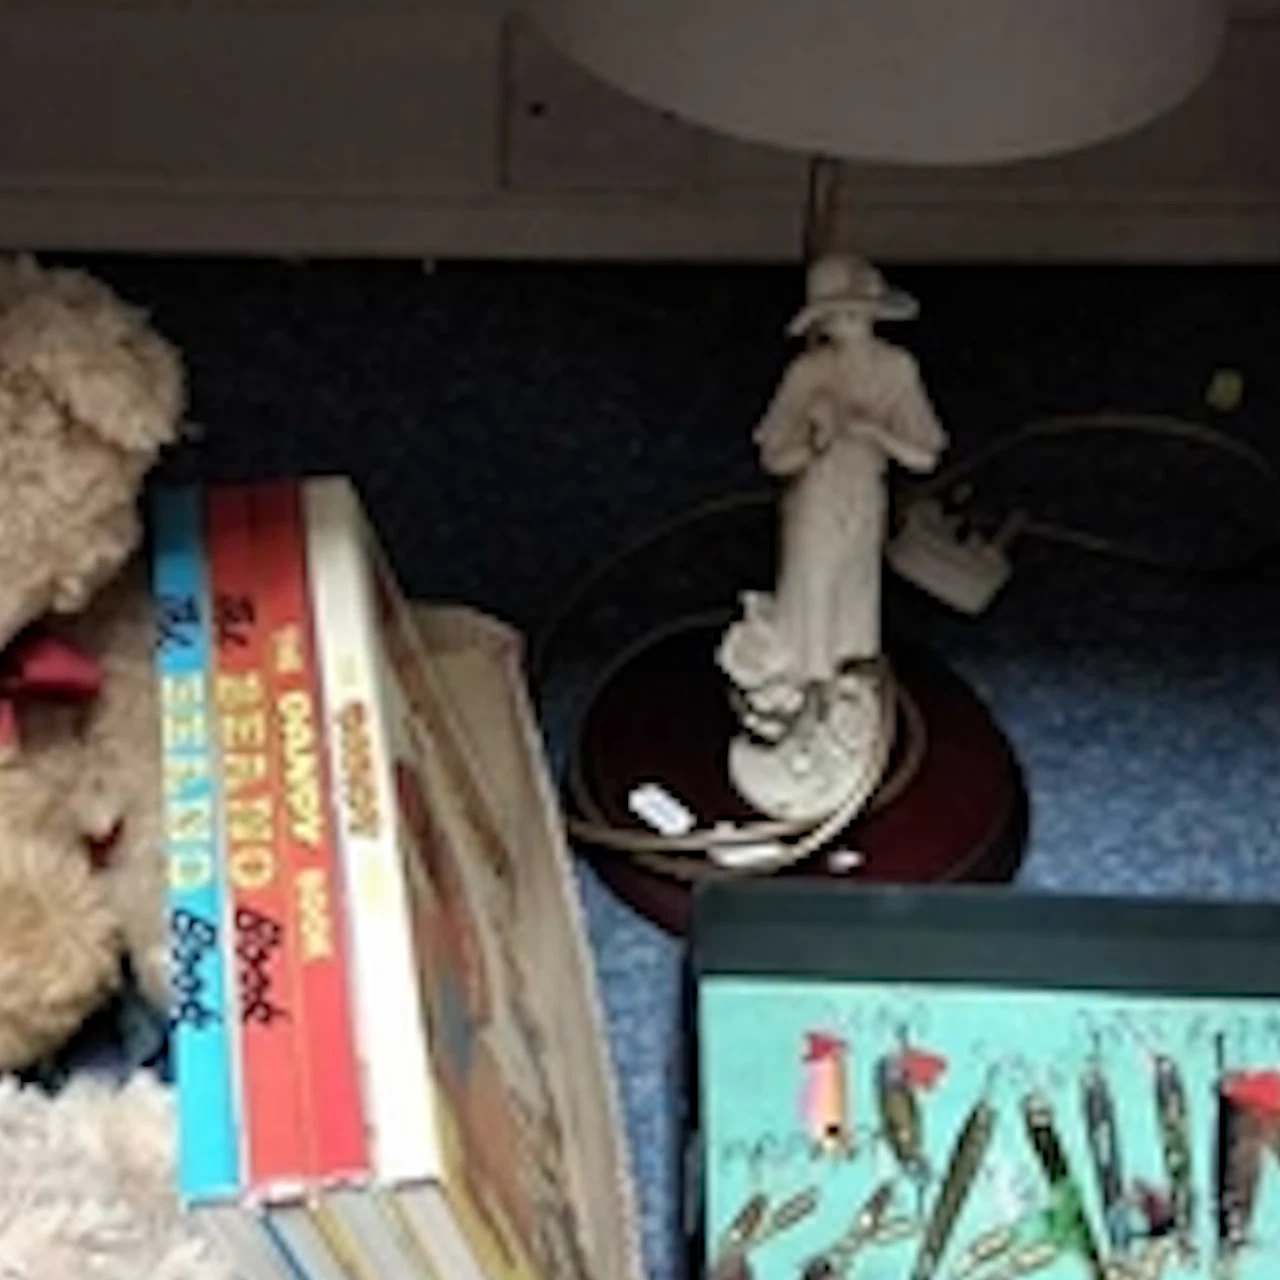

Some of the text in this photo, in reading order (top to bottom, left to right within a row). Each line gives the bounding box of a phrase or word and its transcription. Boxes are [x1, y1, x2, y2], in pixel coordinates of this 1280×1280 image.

[163, 672, 211, 890] BEANO
[216, 672, 277, 888] BEANO
[279, 692, 324, 846] DANDY
